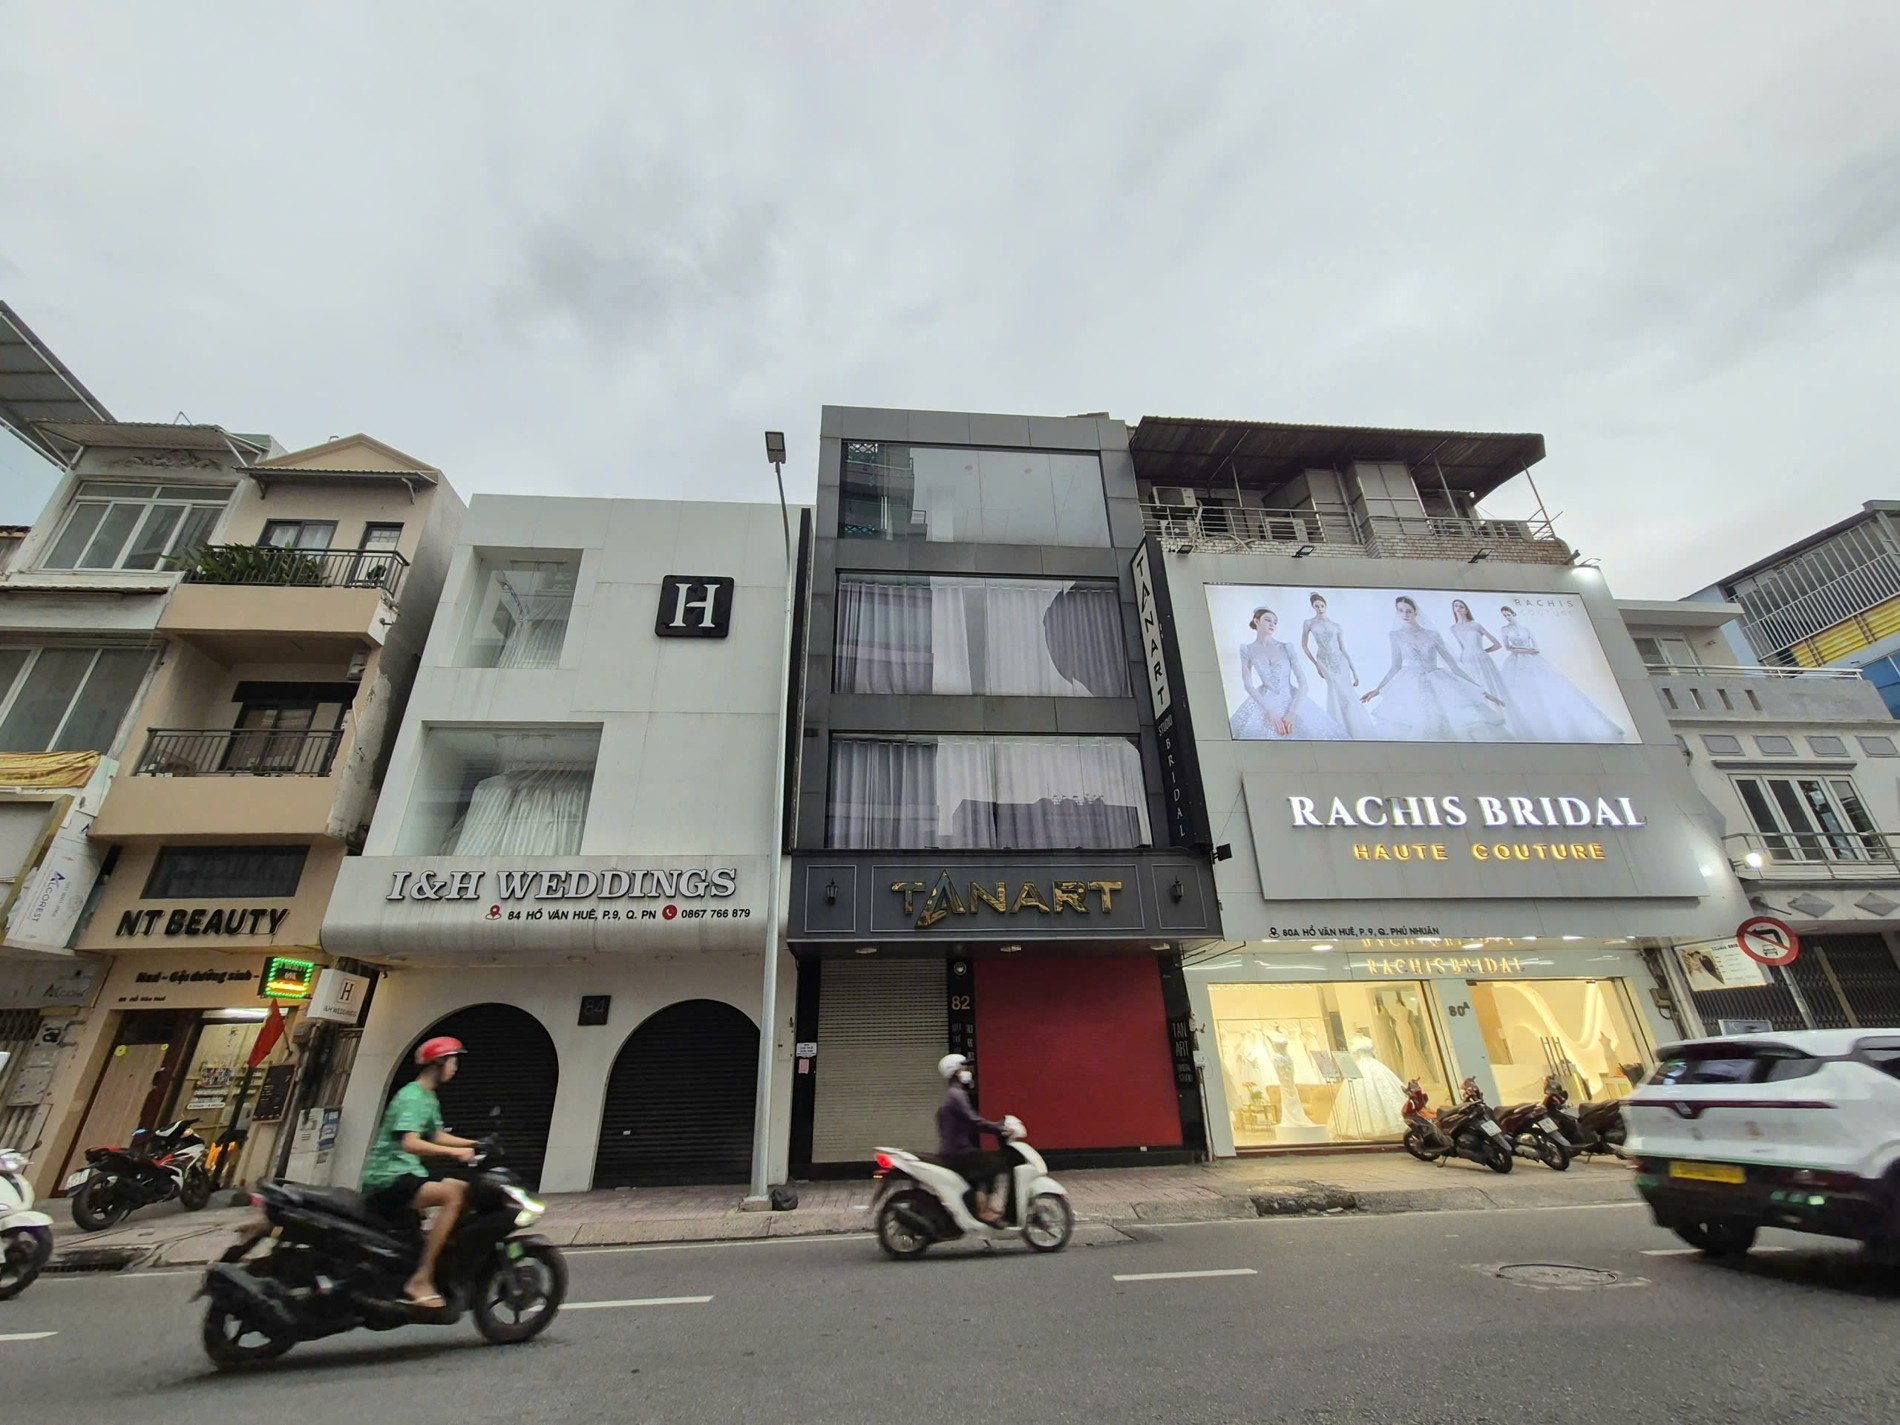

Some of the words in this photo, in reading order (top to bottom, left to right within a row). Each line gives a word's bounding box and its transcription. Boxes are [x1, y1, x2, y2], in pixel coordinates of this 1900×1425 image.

[1514, 599, 1575, 608] RACHIS
[1135, 553, 1168, 701] TANART
[1165, 737, 1185, 837] BRIDAL
[1287, 796, 1467, 827] RACHIS
[1477, 796, 1648, 828] BRIDAL
[1353, 843, 1448, 860] HAUTE
[1471, 843, 1606, 860] COUTURE
[386, 870, 485, 900] I&H
[497, 868, 737, 900] WEDDINGS
[891, 869, 1124, 929] TANART
[115, 909, 164, 936] NT
[164, 908, 289, 936] BEAUTY
[507, 911, 521, 920] 84
[626, 910, 637, 920] Q.
[641, 910, 656, 920] PN
[681, 909, 707, 919] 0867
[710, 909, 729, 919] 766
[732, 908, 751, 918] 879
[1282, 928, 1300, 937] 80A
[1366, 957, 1446, 976] RACHIS
[583, 998, 605, 1016] 84
[951, 995, 971, 1010] 82
